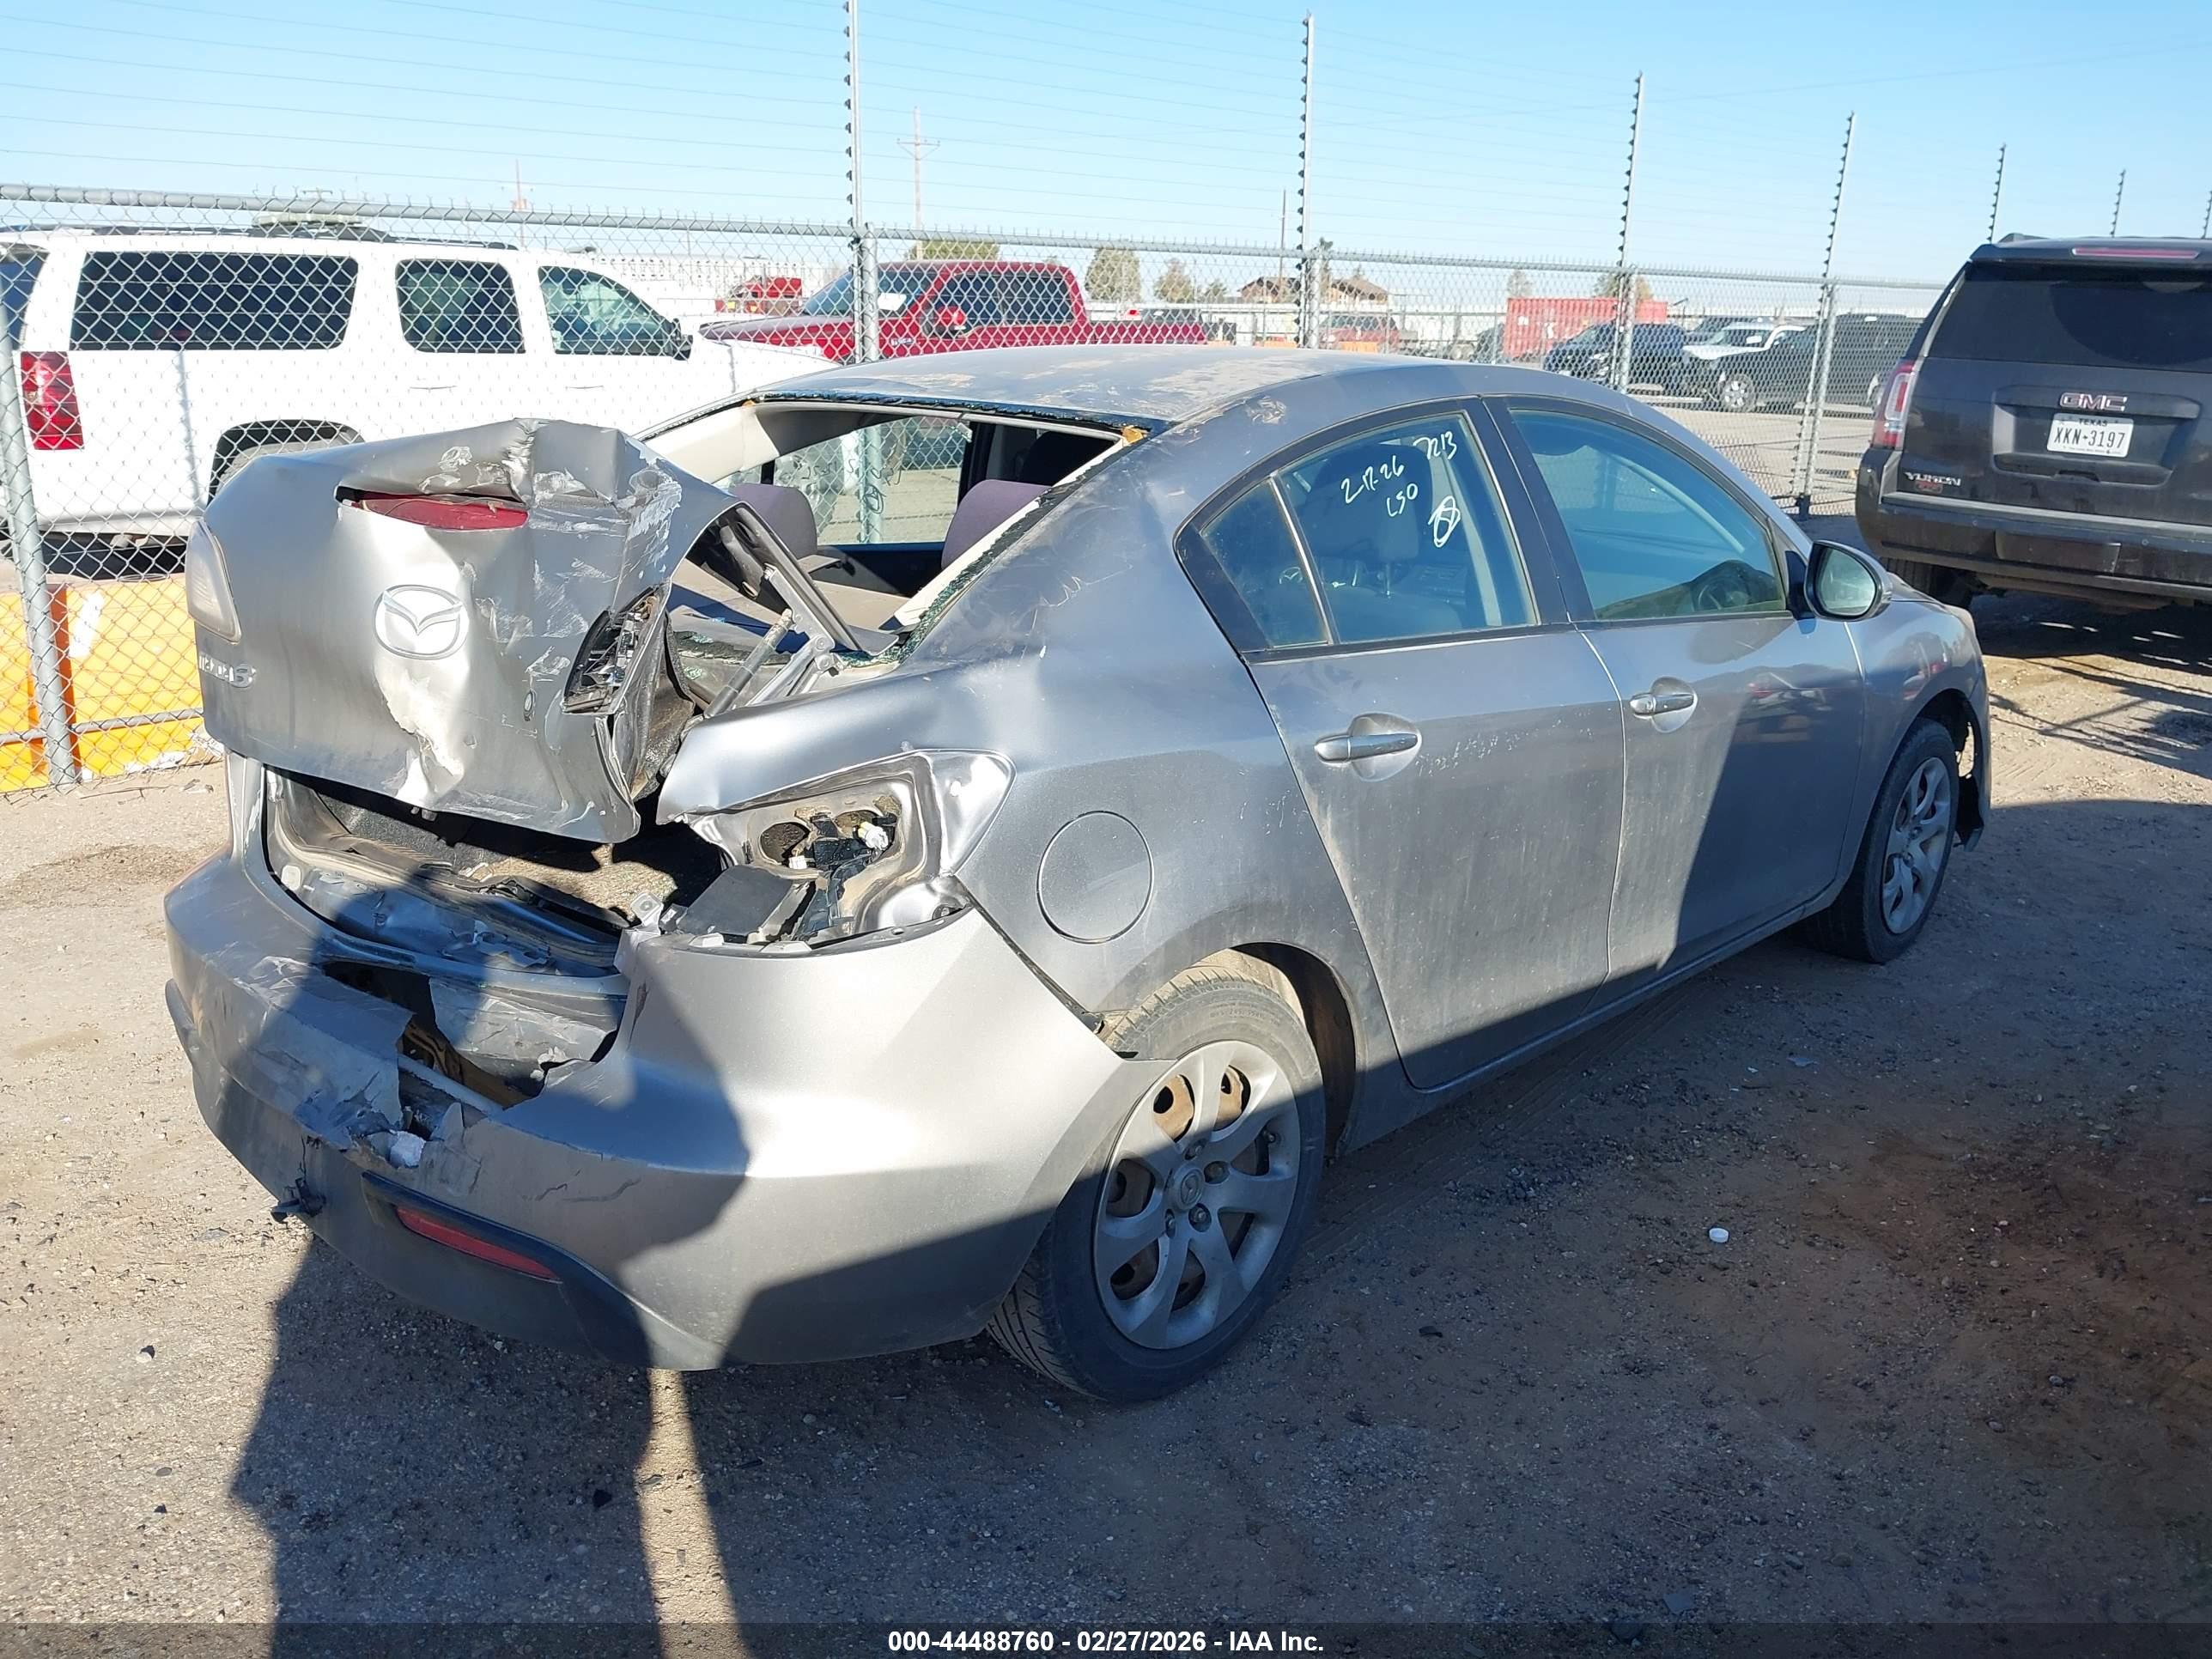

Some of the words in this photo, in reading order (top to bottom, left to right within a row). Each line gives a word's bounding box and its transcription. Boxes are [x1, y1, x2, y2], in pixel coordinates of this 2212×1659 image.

[2060, 392, 2128, 411] GMC
[2079, 418, 2108, 427] TEXAS
[1904, 471, 1961, 487] YUKON
